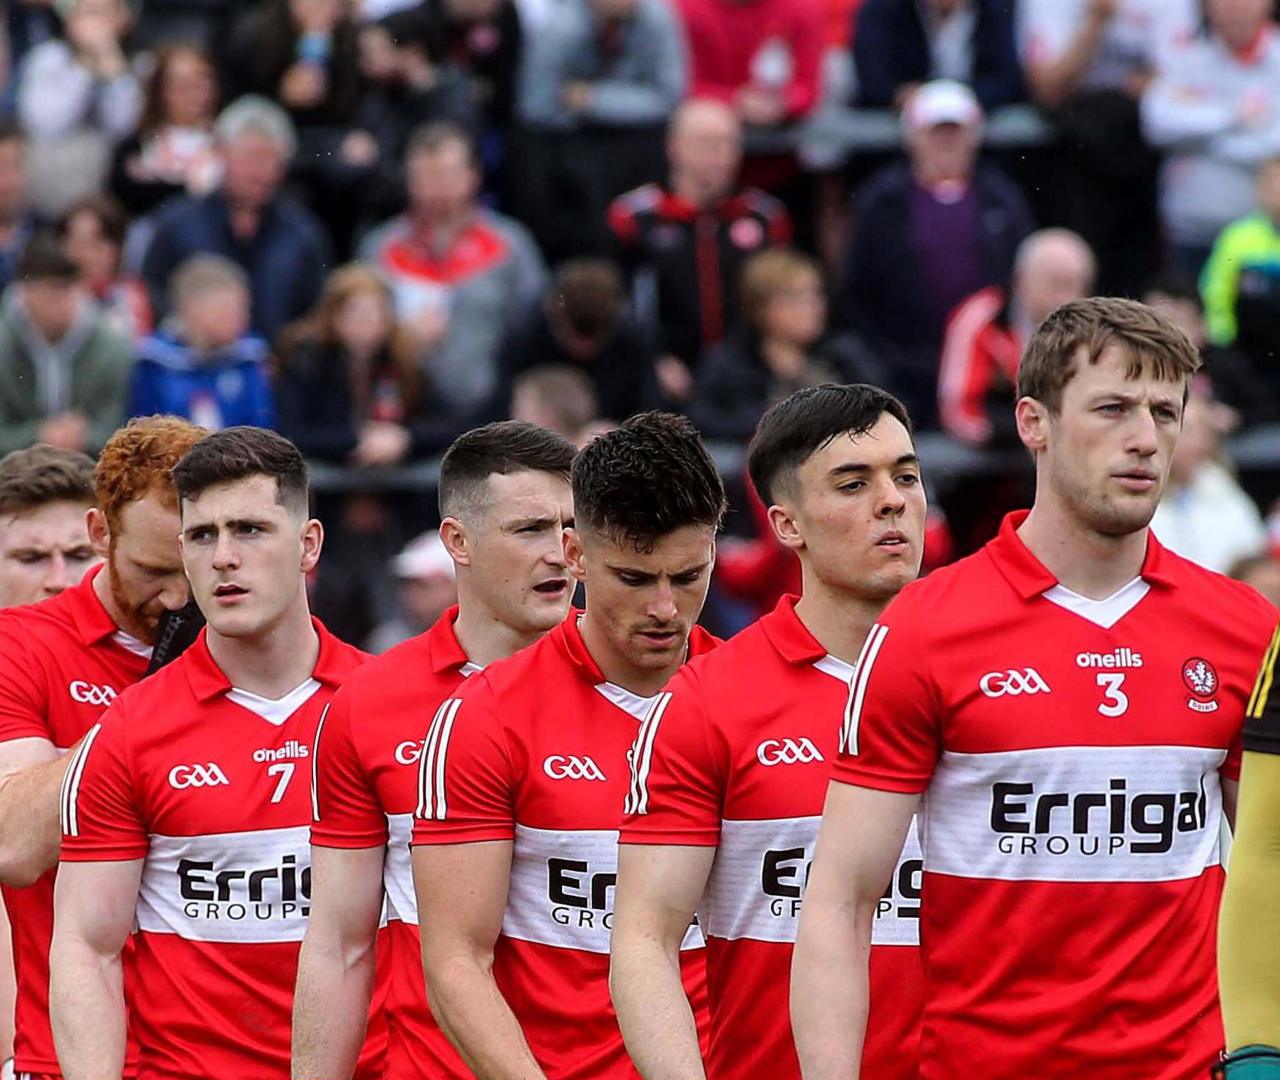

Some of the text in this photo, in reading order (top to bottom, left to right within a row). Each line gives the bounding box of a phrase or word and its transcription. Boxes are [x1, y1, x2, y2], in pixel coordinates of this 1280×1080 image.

[1095, 672, 1130, 717] 3
[267, 762, 296, 804] 7
[998, 835, 1125, 856] GROUP
[183, 902, 297, 920] GROUP
